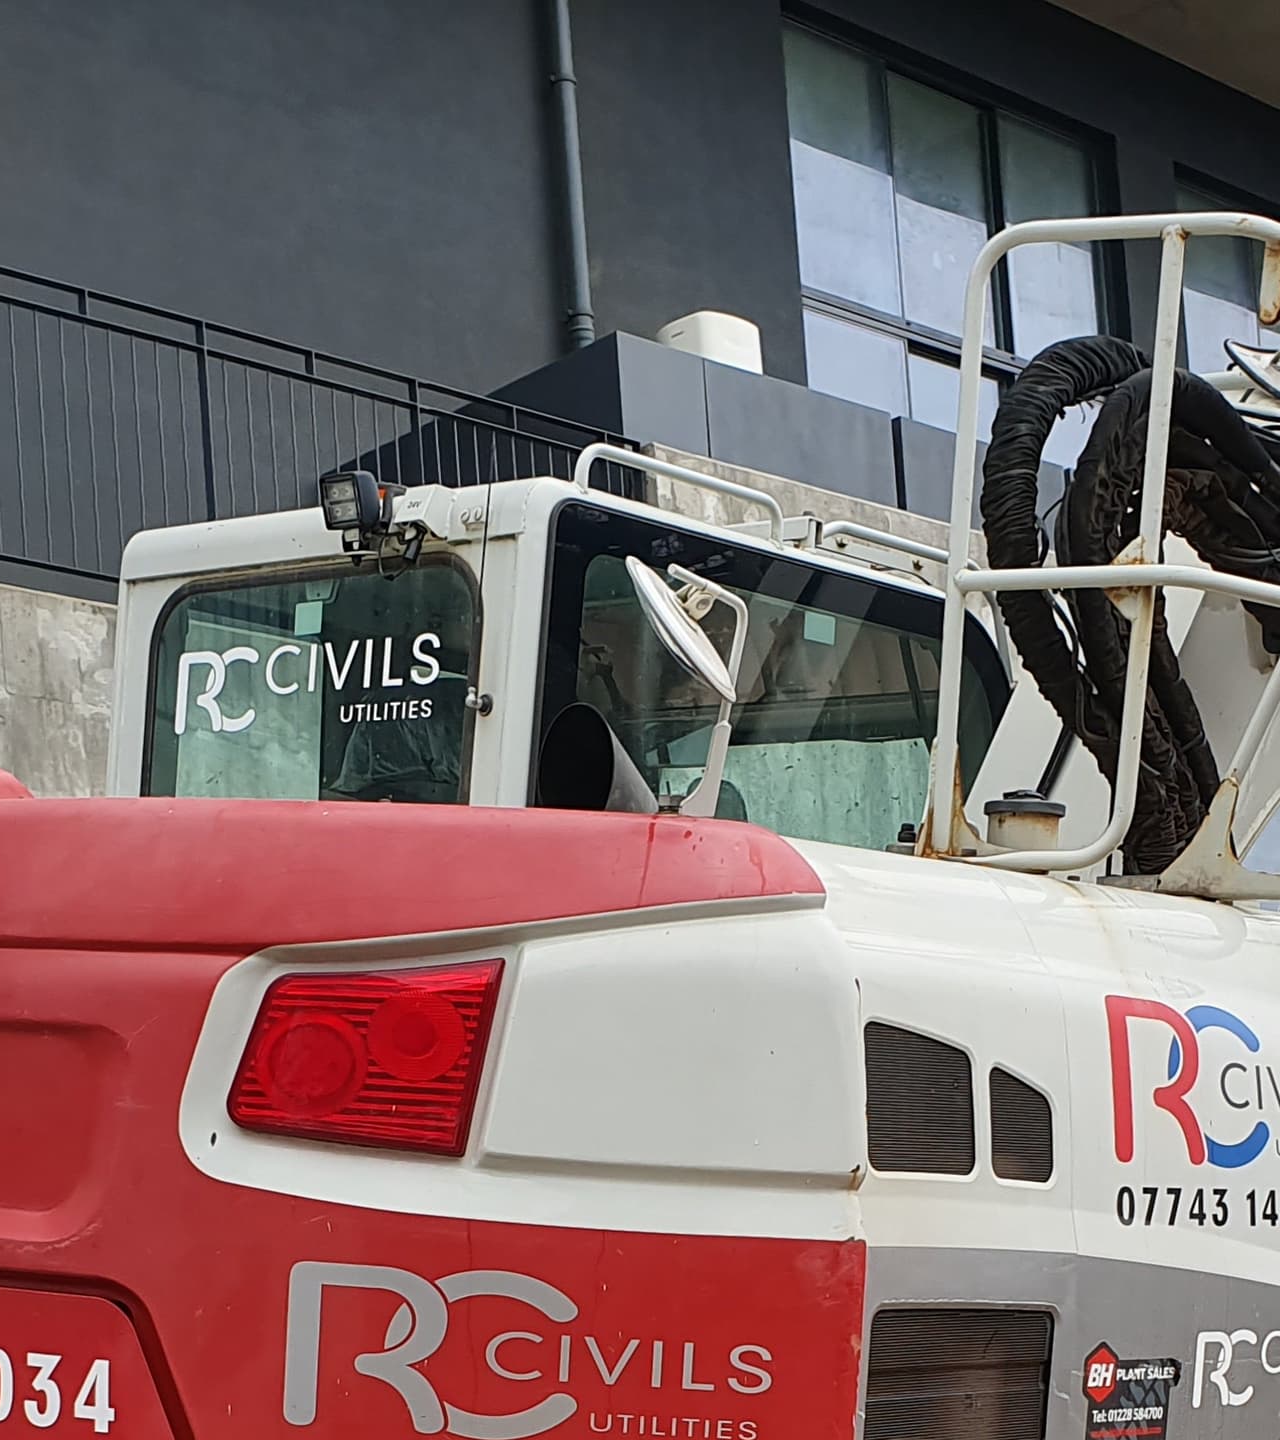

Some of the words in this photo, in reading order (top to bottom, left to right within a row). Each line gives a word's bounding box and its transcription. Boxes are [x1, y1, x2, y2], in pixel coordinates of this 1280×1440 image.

[175, 646, 259, 735] RC
[265, 632, 442, 696] CIVILS
[340, 699, 432, 723] UTILITIES
[1105, 995, 1269, 1168] RC
[1116, 1186, 1228, 1226] 07743
[283, 1260, 578, 1440] RC
[485, 1330, 773, 1394] CIVILS
[1087, 1363, 1114, 1388] BH
[1116, 1368, 1145, 1381] PLANT
[1147, 1367, 1175, 1380] SALES
[1192, 1329, 1258, 1409] RC
[1108, 1408, 1132, 1422] 01228
